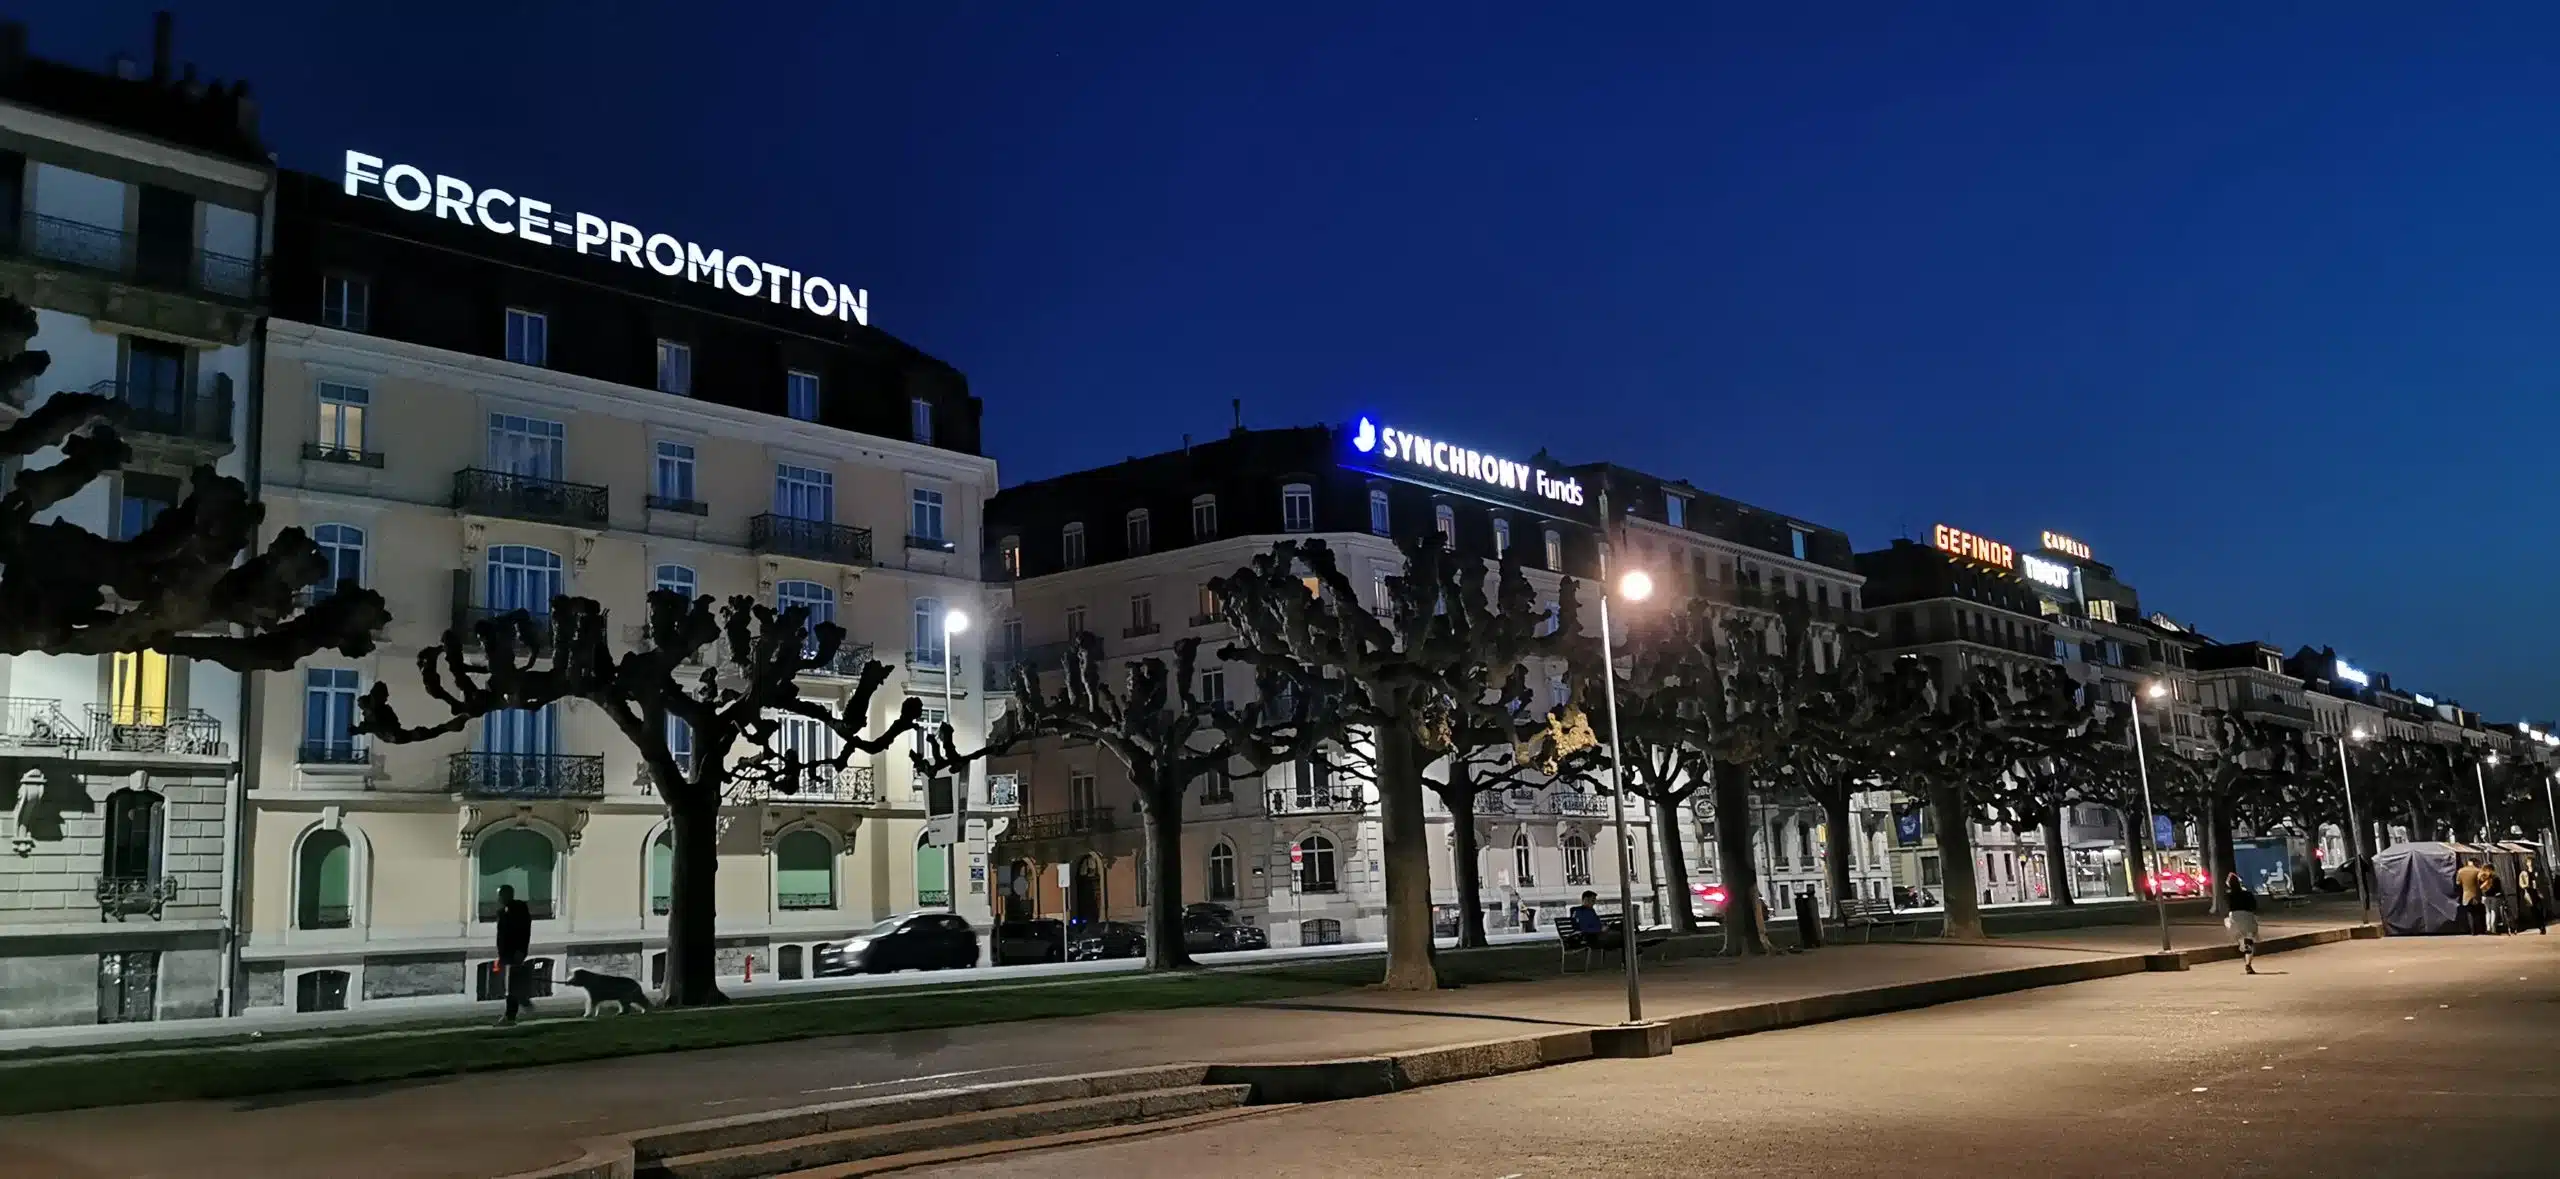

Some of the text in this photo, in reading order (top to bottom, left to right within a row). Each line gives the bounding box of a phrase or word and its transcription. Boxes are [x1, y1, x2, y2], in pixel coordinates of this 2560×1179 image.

[1382, 427, 1584, 506] SYNCHRONY Funds
[1936, 524, 2013, 569] GEFINOR
